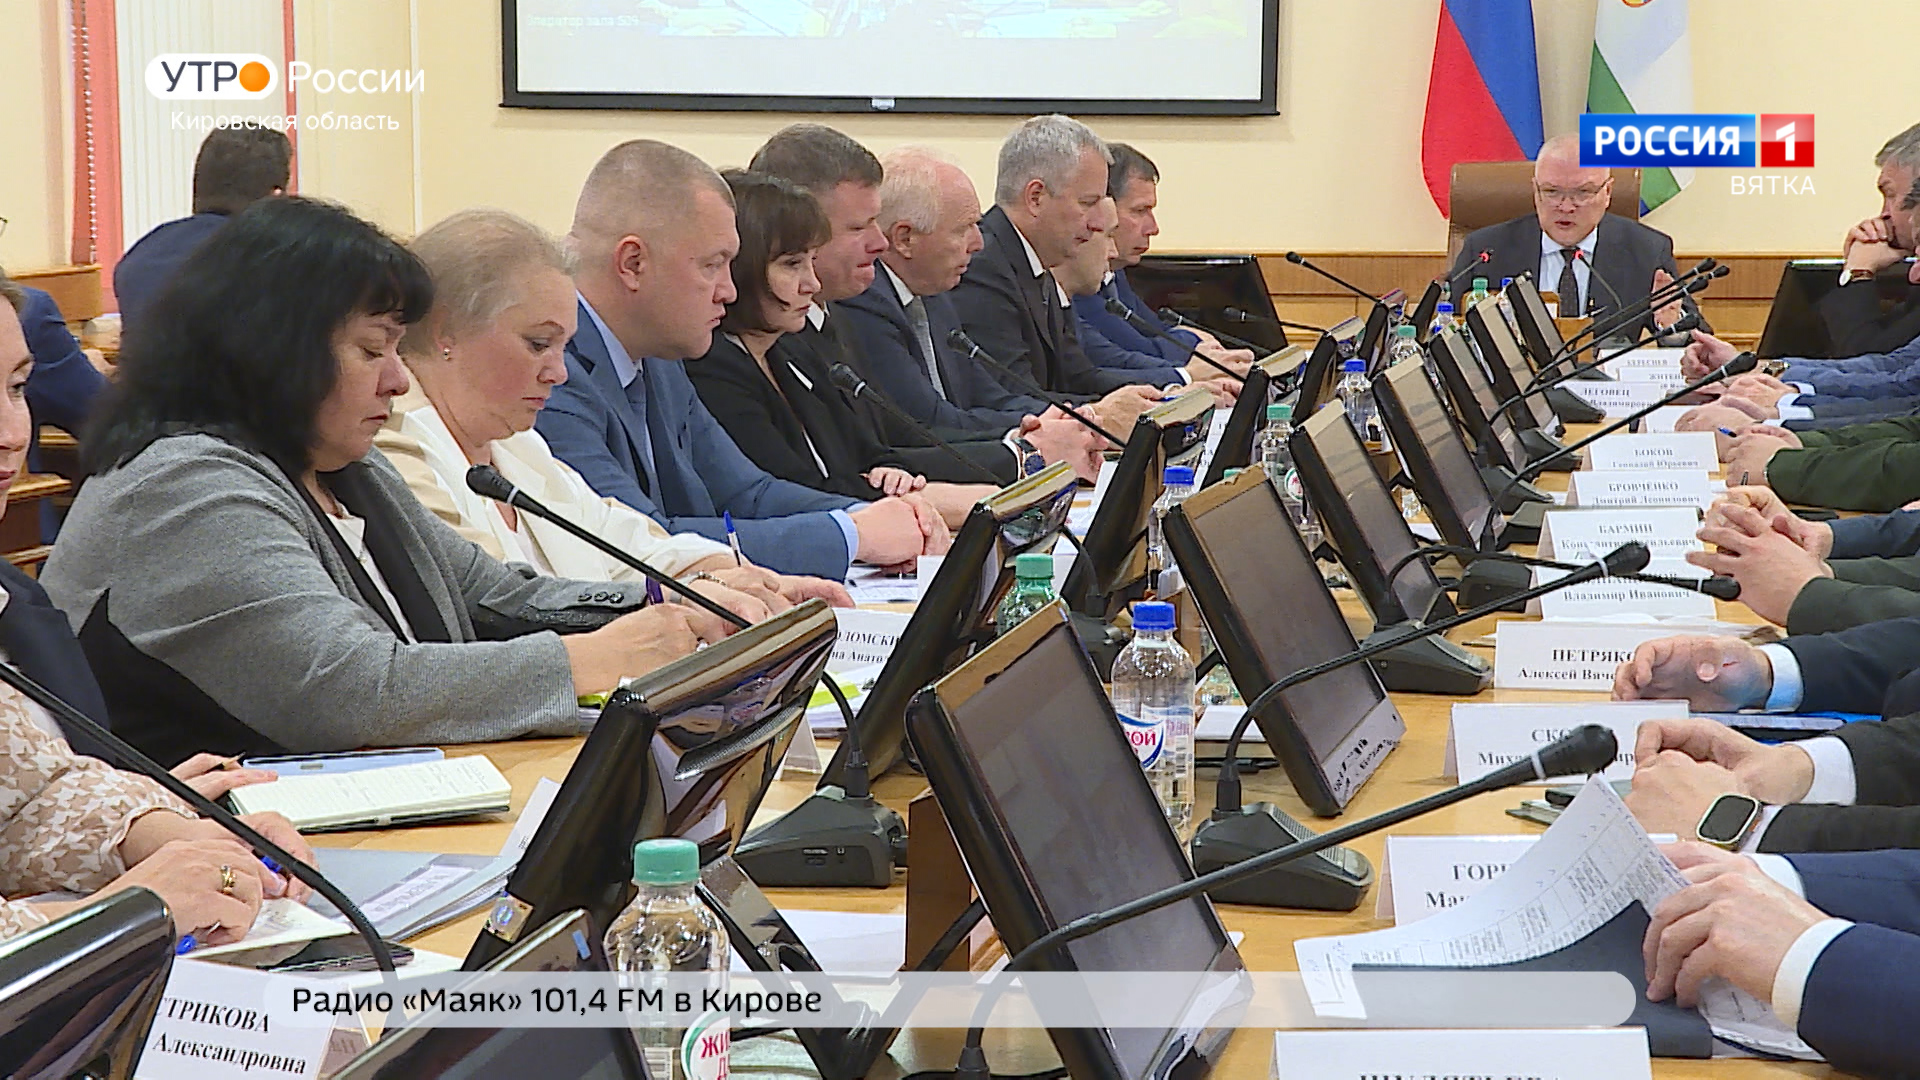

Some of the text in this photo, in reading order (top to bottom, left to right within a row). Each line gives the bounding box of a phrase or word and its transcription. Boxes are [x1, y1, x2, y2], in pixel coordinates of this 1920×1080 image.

[1608, 481, 1679, 492] БРОВЧЕНКО
[1598, 523, 1654, 534] БАРМИН
[1563, 589, 1691, 602] Владимир Иванович
[1518, 667, 1578, 680] Алексей
[162, 997, 270, 1034] ТРИКОВА
[152, 1032, 307, 1075] Александровна
